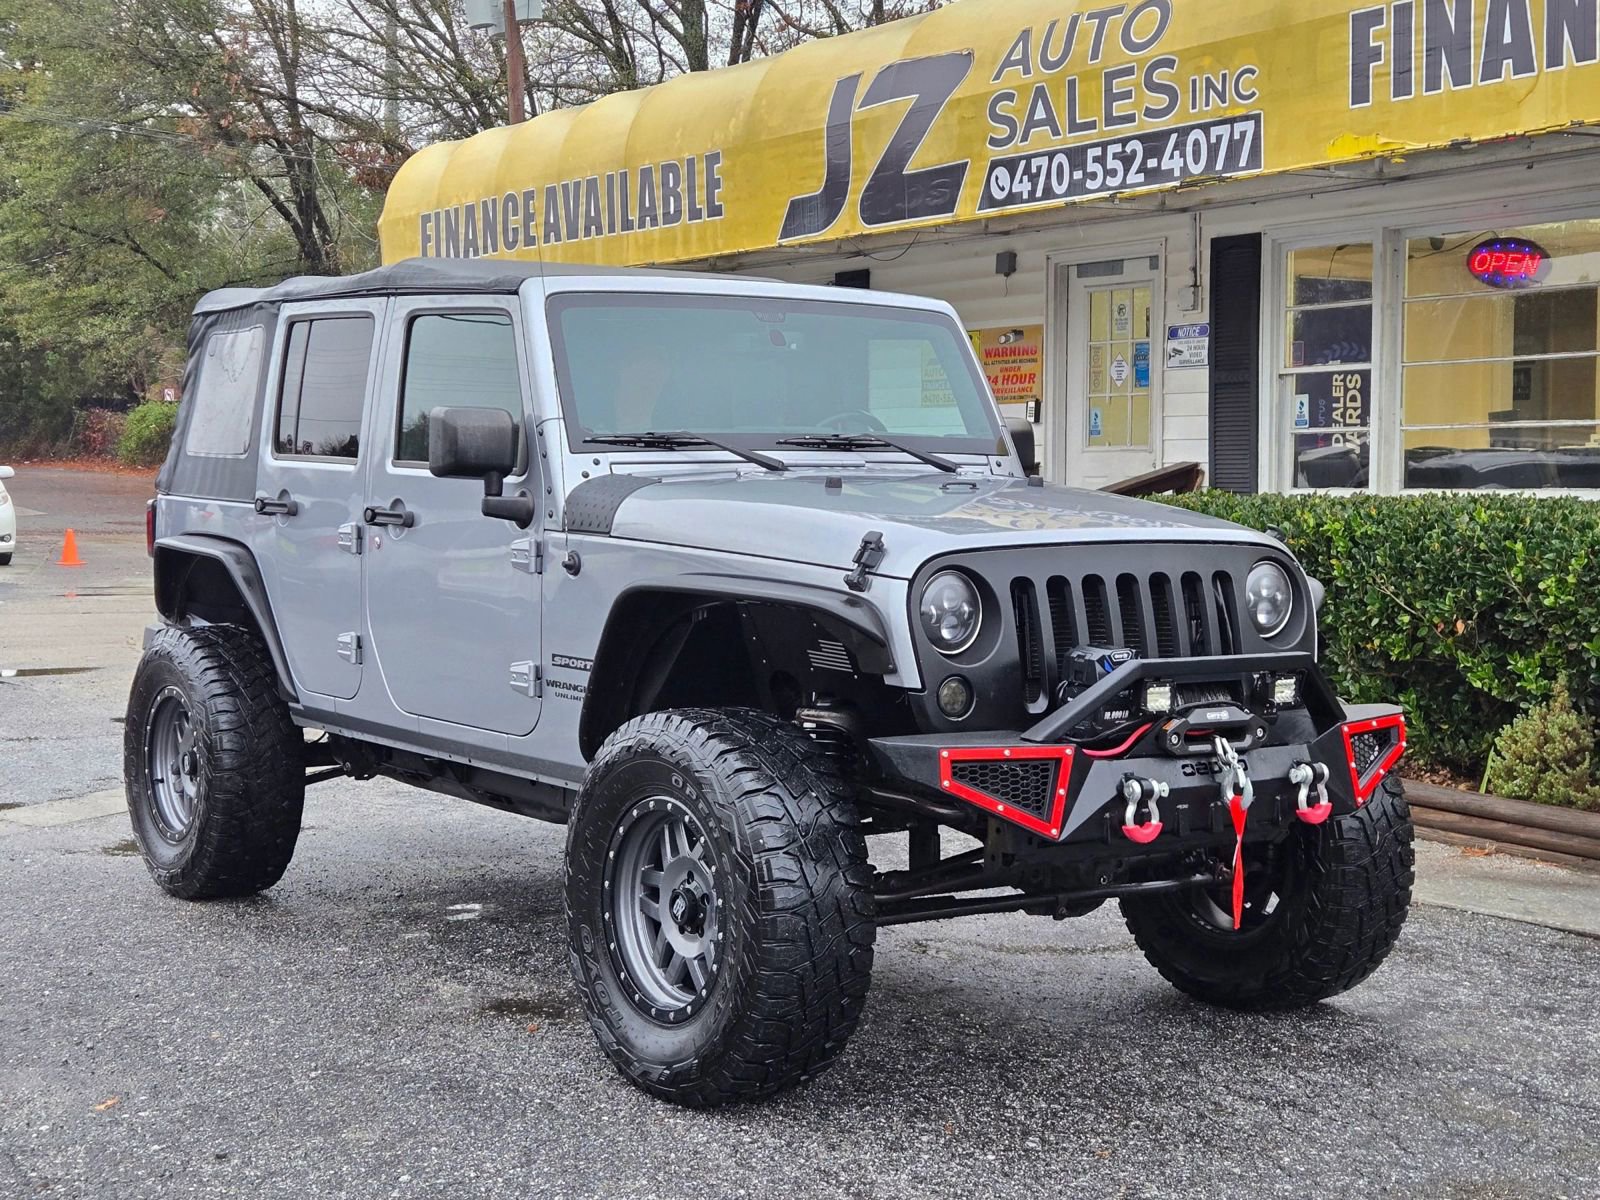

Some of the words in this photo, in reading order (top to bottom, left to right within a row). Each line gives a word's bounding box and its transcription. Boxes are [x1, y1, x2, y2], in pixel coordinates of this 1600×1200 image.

[990, 0, 1173, 84] AUTO
[986, 54, 1180, 150] SALES
[1189, 64, 1260, 114] INC
[776, 50, 975, 244] JZ
[1011, 119, 1257, 201] 470-552-4077
[420, 187, 538, 260] FINANCE
[542, 149, 724, 247] AVAILABLE
[1475, 252, 1540, 275] OPEN
[1177, 326, 1201, 337] NOTICE
[984, 344, 1038, 359] WARNING
[1001, 372, 1037, 386] HOUR
[552, 655, 594, 670] SPORT
[554, 691, 585, 702] UNLIMI
